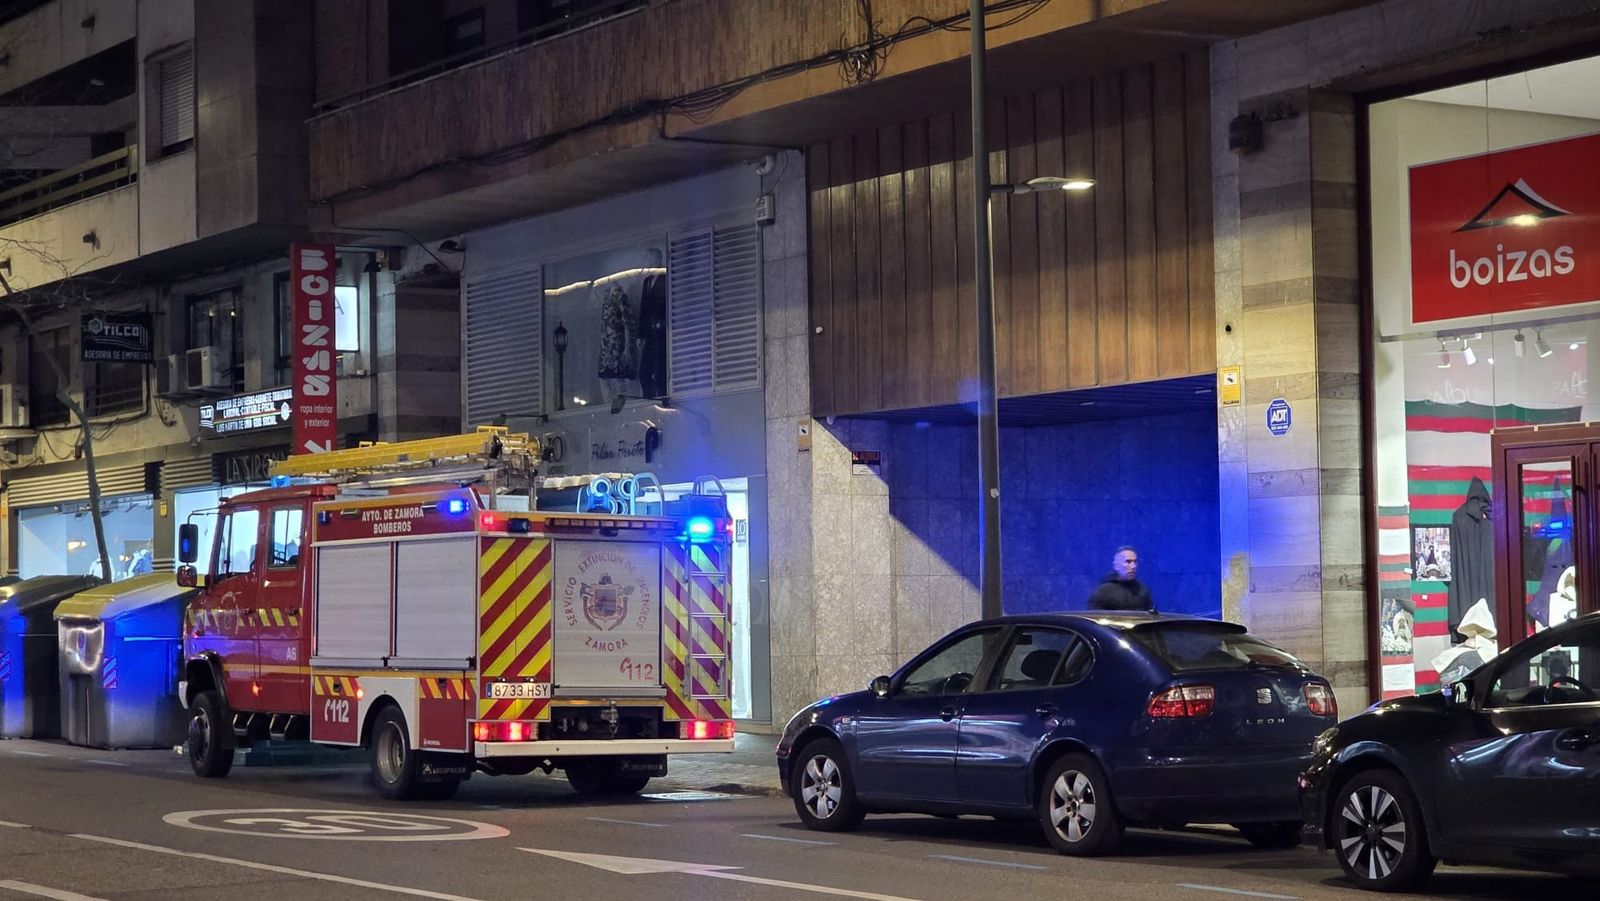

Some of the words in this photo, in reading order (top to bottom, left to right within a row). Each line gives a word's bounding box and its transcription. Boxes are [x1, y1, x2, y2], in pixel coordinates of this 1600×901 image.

[1449, 244, 1575, 288] boizas
[104, 325, 140, 336] TILCO
[300, 405, 313, 415] ropa
[313, 403, 333, 414] interior
[1271, 409, 1287, 423] ADT
[309, 418, 330, 427] exterior
[361, 509, 382, 522] AYTO.
[383, 508, 393, 520] DE
[394, 506, 424, 519] ZAMORA
[373, 521, 412, 534] BOMBEROS
[564, 577, 578, 626] SERVICIO
[585, 636, 629, 652] ZAMORA
[286, 647, 297, 661] A6
[625, 663, 654, 680] 112
[494, 684, 524, 697] 8733
[527, 684, 548, 697] HSY
[330, 699, 350, 723] 112
[222, 814, 451, 834] 30
